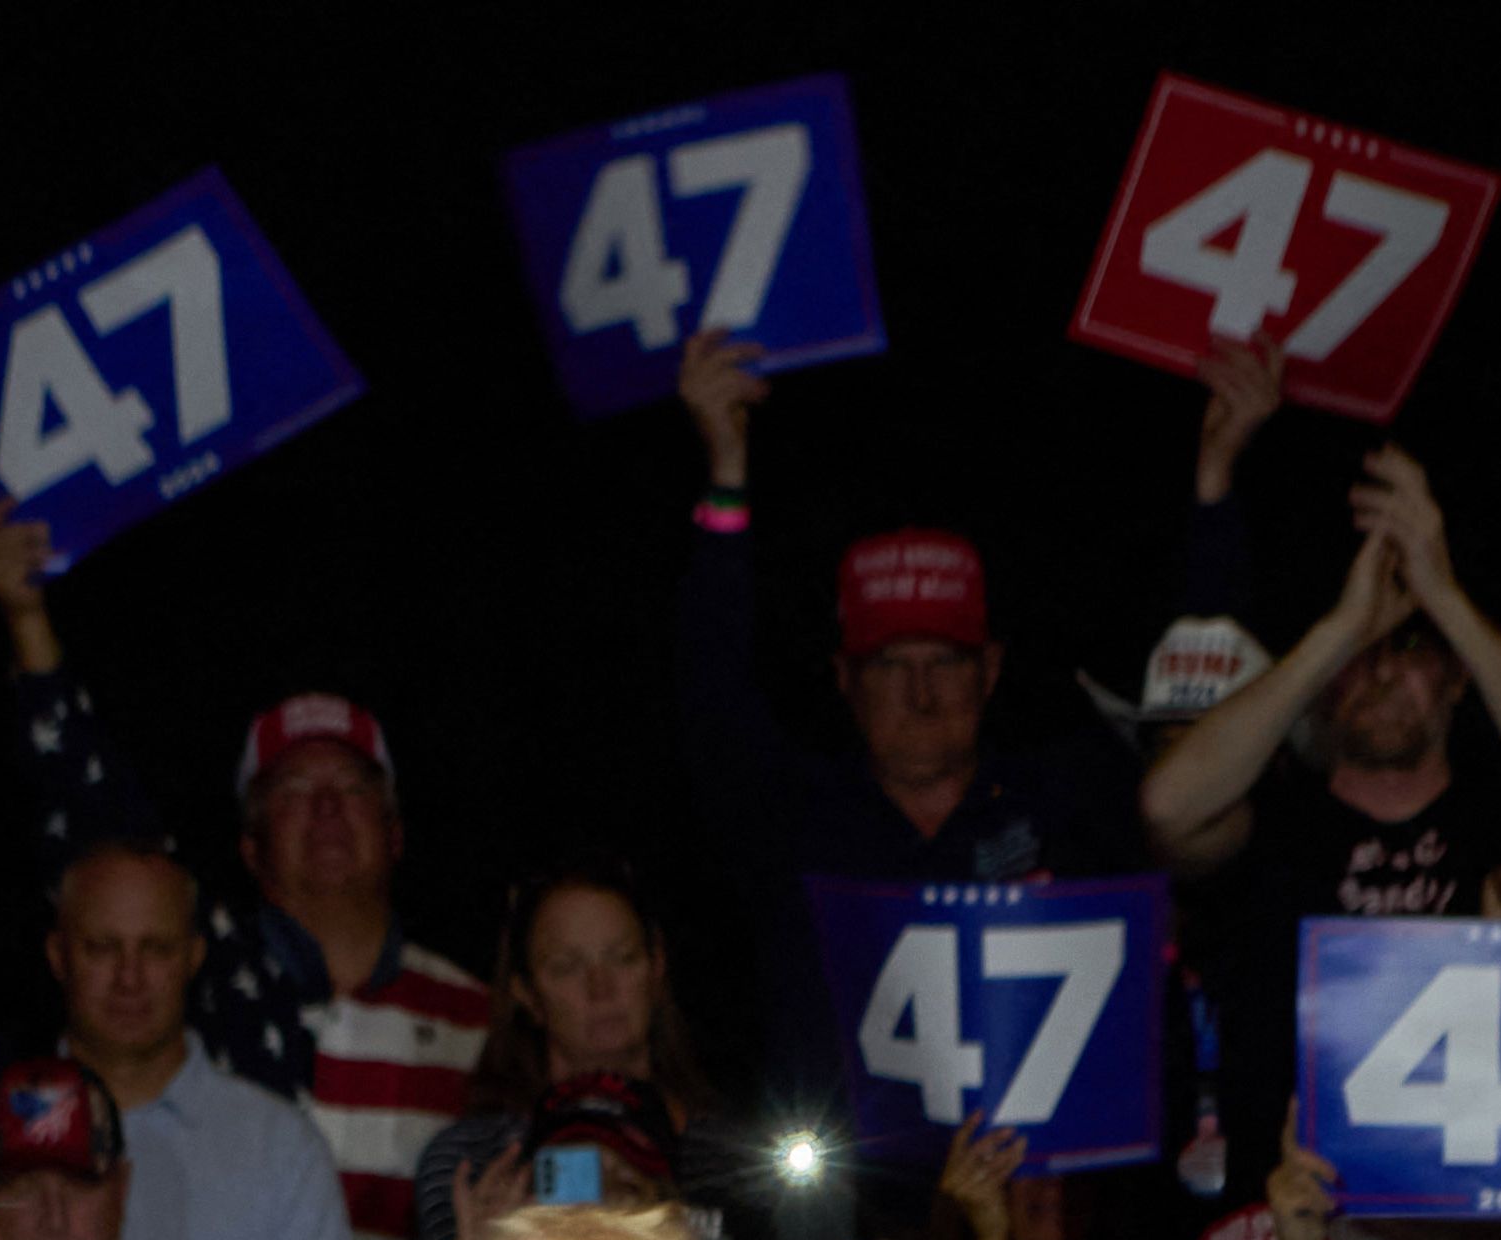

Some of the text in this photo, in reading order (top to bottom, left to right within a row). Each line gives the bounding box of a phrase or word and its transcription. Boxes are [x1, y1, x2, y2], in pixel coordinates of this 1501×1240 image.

[557, 120, 812, 352] 47
[1139, 146, 1449, 362] 47
[858, 917, 1127, 1126] 47
